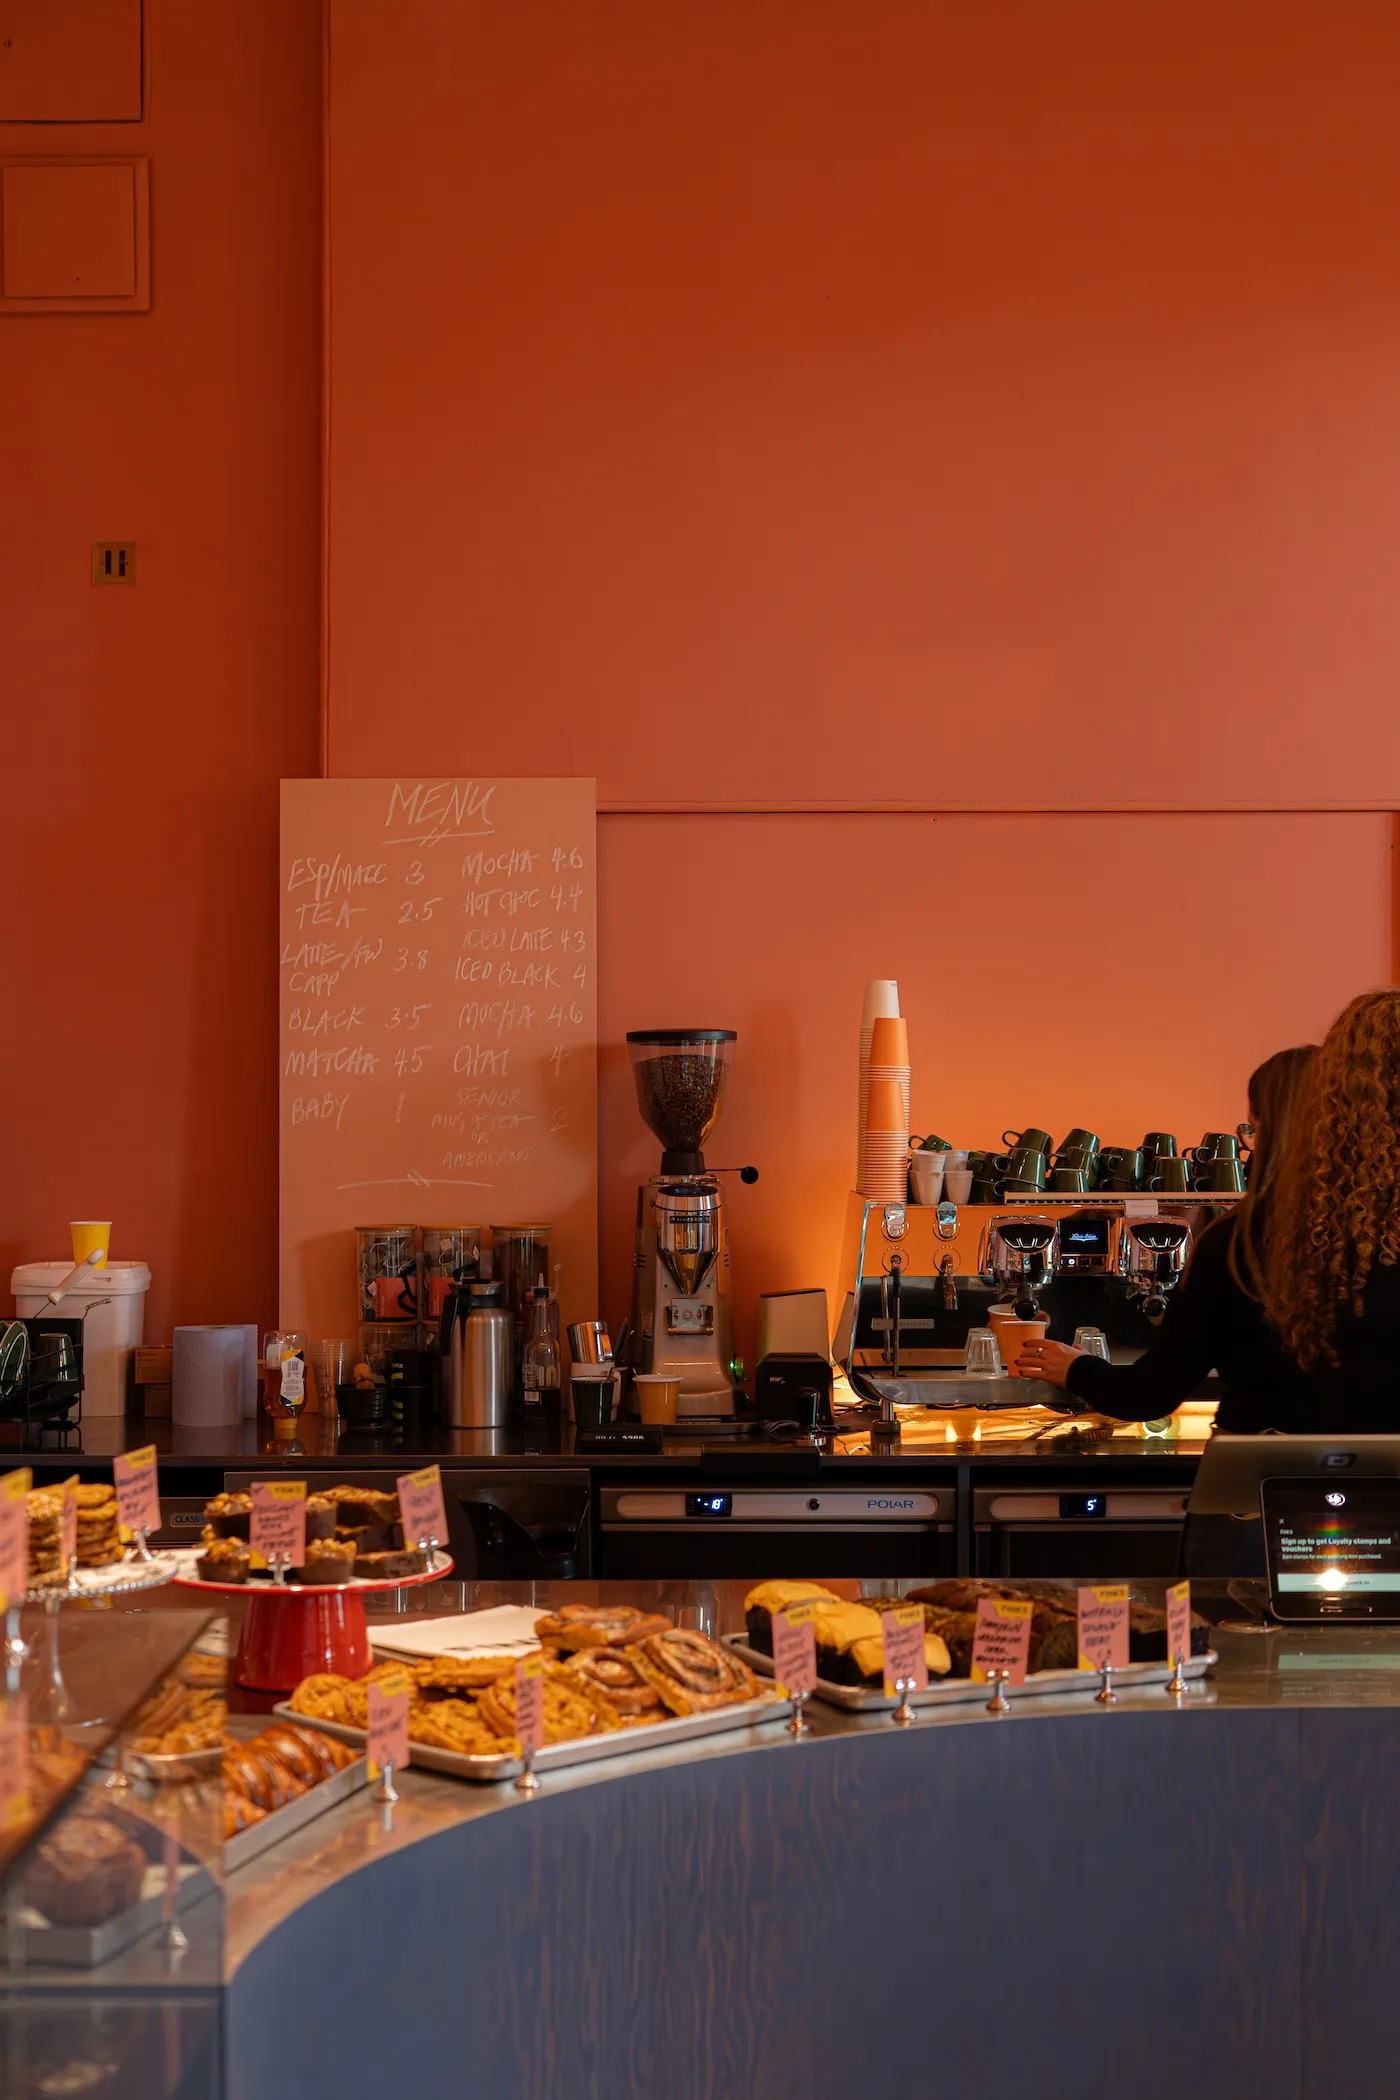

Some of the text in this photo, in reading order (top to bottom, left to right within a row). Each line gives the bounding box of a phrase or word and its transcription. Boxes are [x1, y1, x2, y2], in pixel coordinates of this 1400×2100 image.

[385, 781, 496, 826] MENU
[405, 861, 425, 885] 3
[461, 846, 583, 884] MOCHA 4.6
[296, 897, 443, 930] TEA 2.5
[464, 883, 583, 917] HOT CHOC 4.4
[463, 928, 506, 950] ICED
[560, 929, 587, 953] 4.3
[393, 947, 428, 972] 3.8
[454, 956, 587, 989] ICED BLACK 4
[288, 1003, 433, 1036] BLACK 3.5
[458, 998, 583, 1037] MOCHA 4.6
[284, 1044, 433, 1077] MATCHA 4.5
[549, 1044, 570, 1076] 4
[550, 1106, 570, 1132] 2
[867, 1500, 914, 1509] POLAR
[1281, 1538, 1296, 1546] Sign
[1298, 1538, 1307, 1546] up
[1316, 1538, 1327, 1546] get
[1328, 1538, 1352, 1546] Loyalty
[1353, 1538, 1377, 1546] stamps
[1378, 1537, 1391, 1545] and
